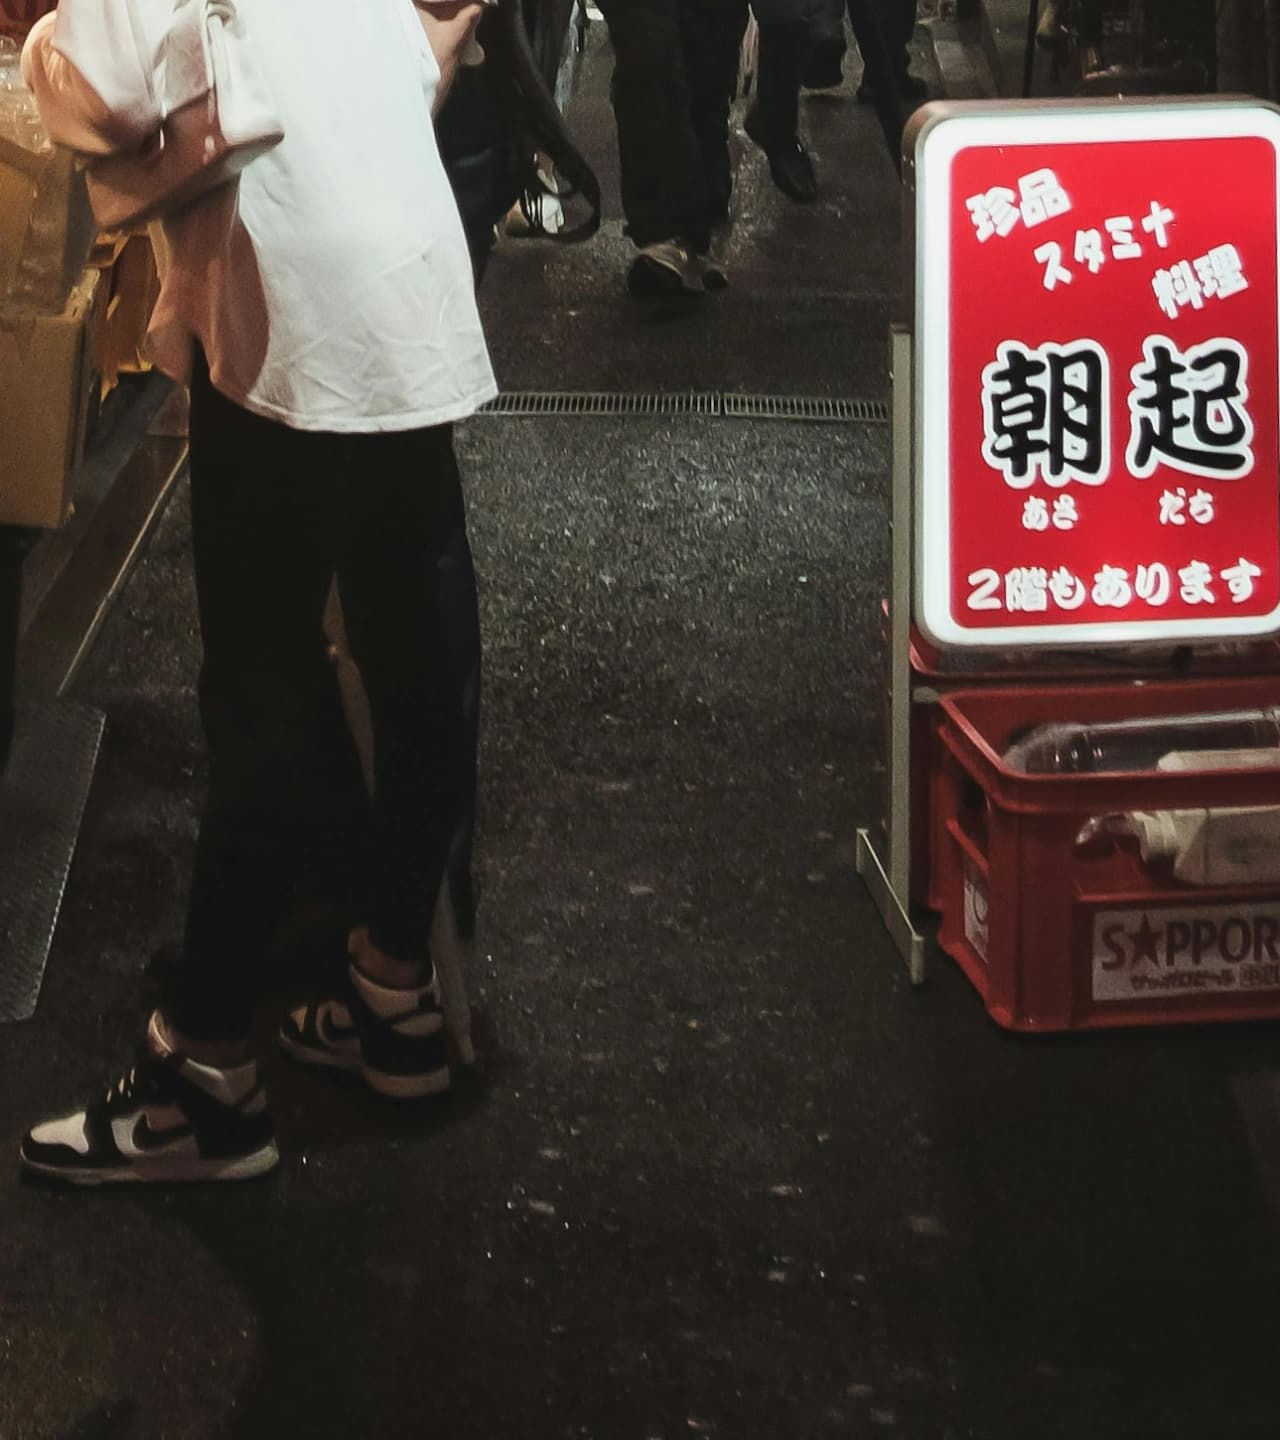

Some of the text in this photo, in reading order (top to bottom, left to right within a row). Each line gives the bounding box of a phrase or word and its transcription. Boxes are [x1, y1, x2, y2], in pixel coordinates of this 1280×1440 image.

[965, 167, 1249, 319] 珍品 スタミナ 料理
[982, 335, 1253, 486] 朝起
[1022, 487, 1215, 531] あさ だち
[966, 557, 1263, 613] 2階もあります
